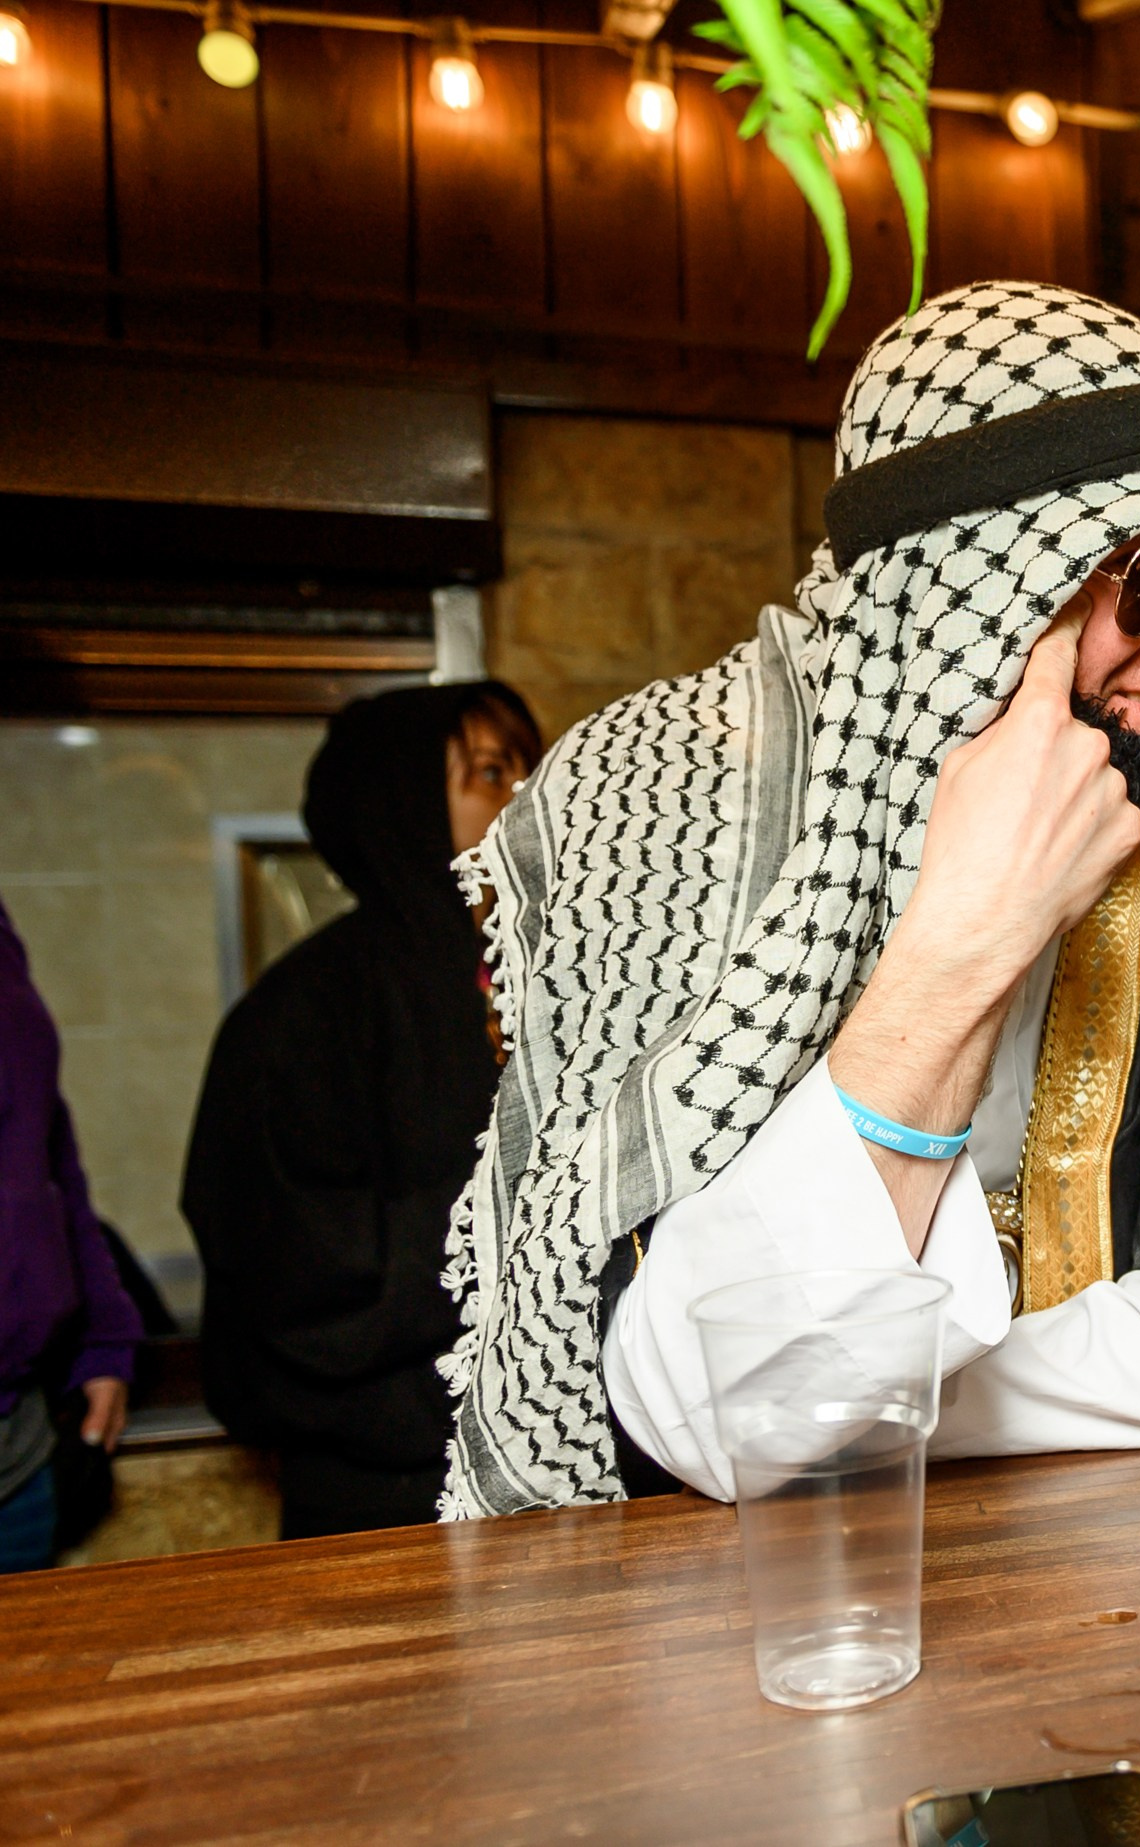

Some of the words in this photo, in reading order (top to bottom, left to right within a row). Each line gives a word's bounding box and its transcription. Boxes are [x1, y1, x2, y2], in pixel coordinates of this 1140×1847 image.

[855, 1116, 865, 1127] 2
[863, 1120, 877, 1134] BE
[875, 1126, 904, 1144] HAPPY
